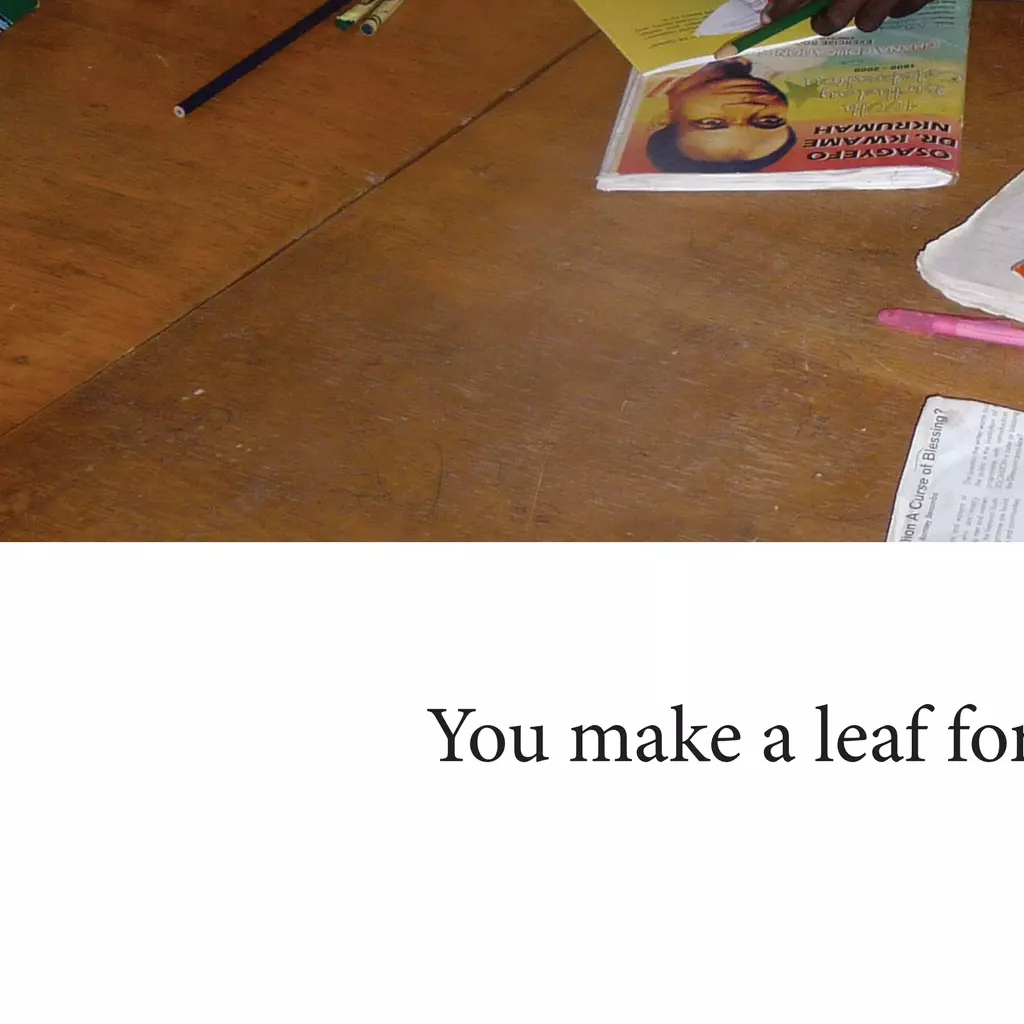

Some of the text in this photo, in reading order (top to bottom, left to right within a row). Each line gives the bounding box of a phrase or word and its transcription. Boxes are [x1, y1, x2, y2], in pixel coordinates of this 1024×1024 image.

[812, 120, 951, 137] NKRUMAH
[802, 132, 958, 149] DR. KWAME
[806, 146, 951, 162] OSAGYEFO
[920, 406, 949, 462] Blessing?
[917, 462, 933, 476] of
[908, 475, 929, 511] Curse
[905, 509, 919, 521] A
